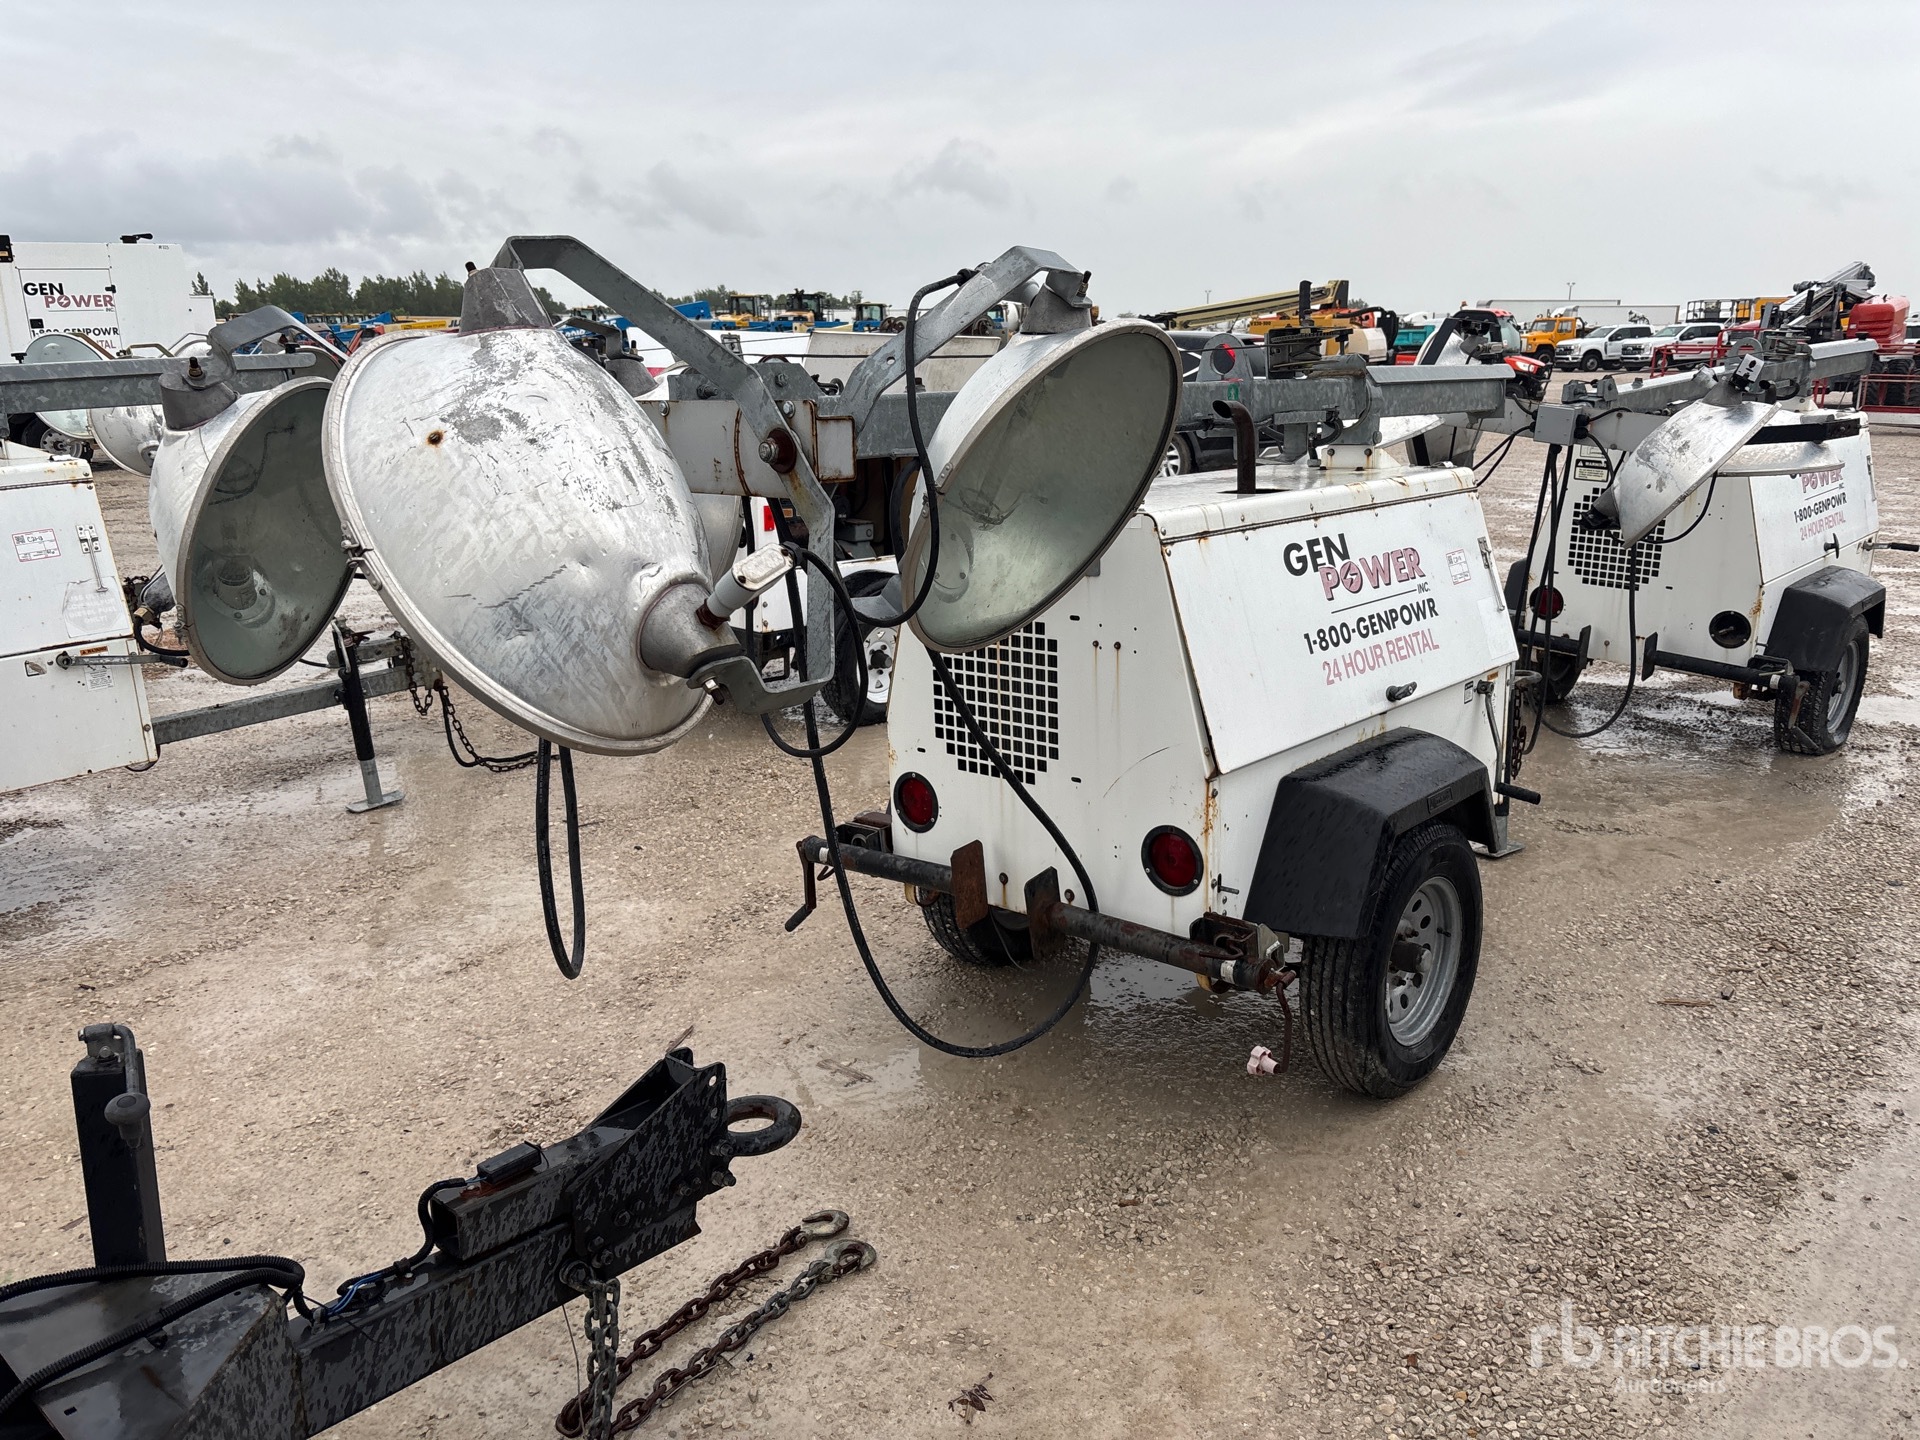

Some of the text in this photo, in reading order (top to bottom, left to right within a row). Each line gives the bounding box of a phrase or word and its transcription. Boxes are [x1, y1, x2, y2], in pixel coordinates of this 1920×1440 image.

[23, 282, 65, 296] GEN
[44, 294, 115, 308] POWER
[1801, 468, 1843, 493] POWER
[1793, 492, 1847, 523] 1-800-GENPOWR
[1799, 511, 1846, 541] 24 HOUR RENTAL
[1282, 532, 1351, 577] GEN
[1318, 547, 1426, 601] POWER
[1416, 582, 1431, 595] INC.
[1303, 597, 1439, 655] 1-800-GENPOWR
[1322, 628, 1440, 686] 24 HOUR RENTAL
